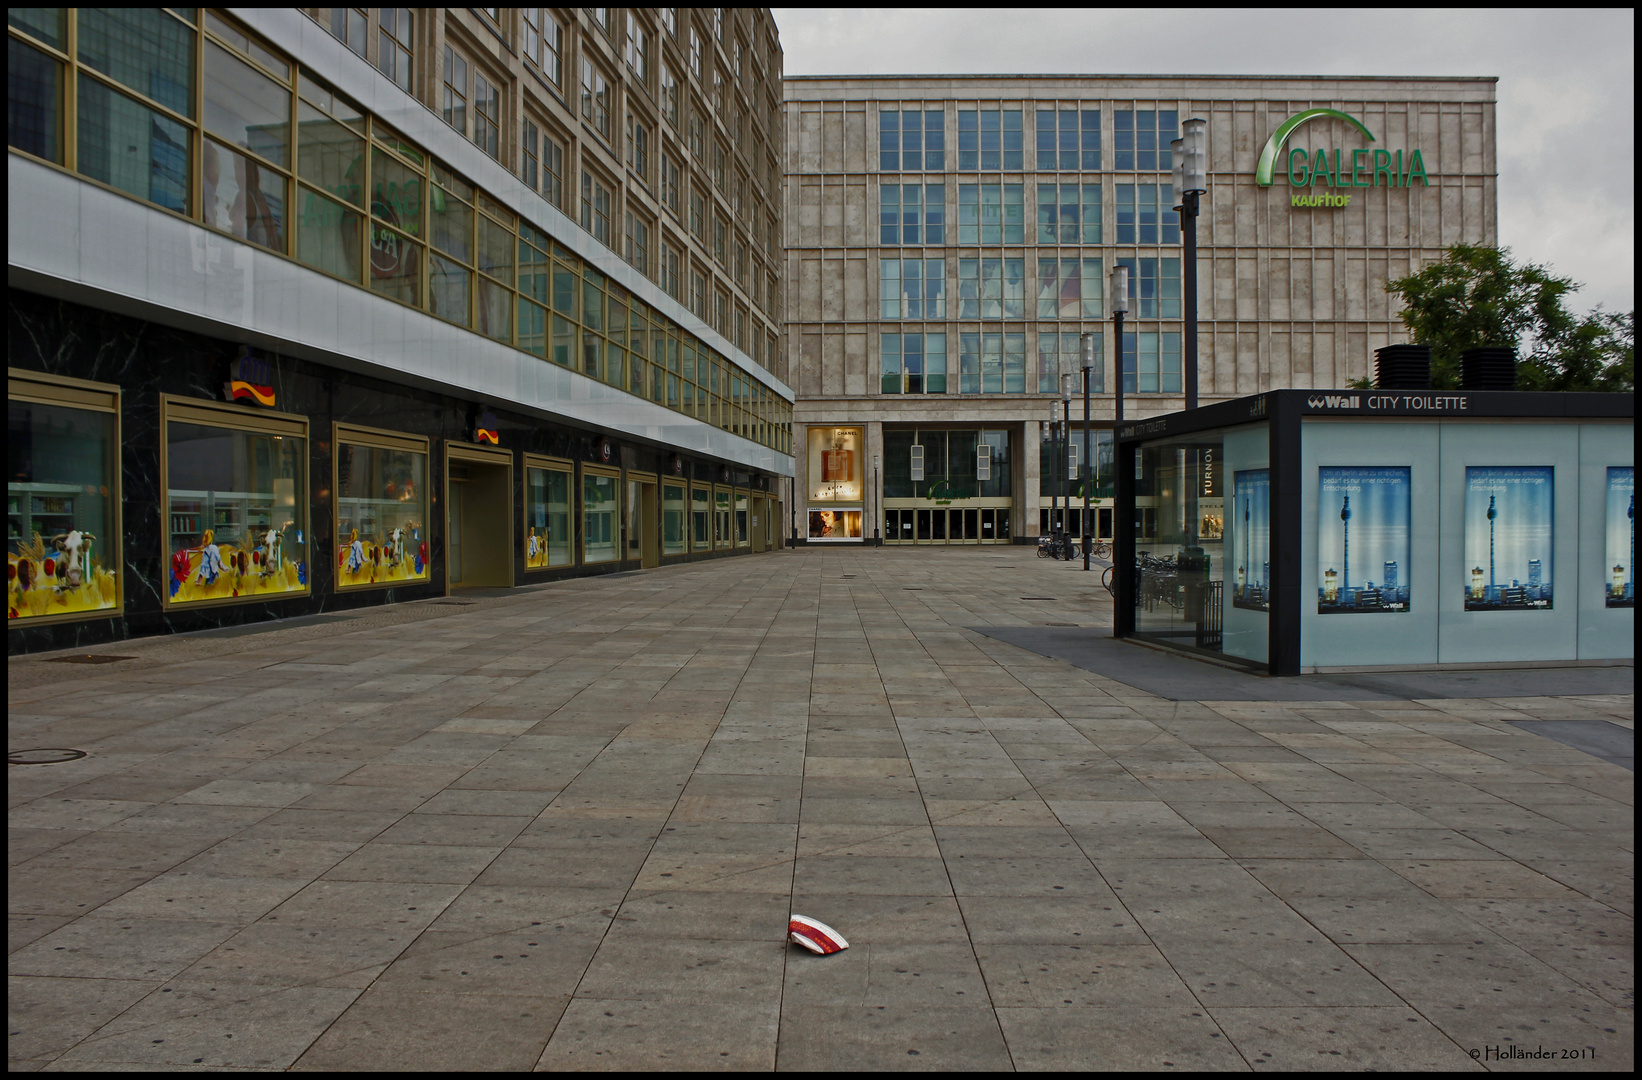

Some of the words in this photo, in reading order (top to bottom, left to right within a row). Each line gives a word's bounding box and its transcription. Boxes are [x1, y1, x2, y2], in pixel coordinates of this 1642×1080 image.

[1287, 148, 1429, 188] GALERIA
[239, 345, 271, 385] dm
[1325, 395, 1360, 409] Wall
[1368, 396, 1399, 409] CITY
[1403, 396, 1467, 409] TOILETTE
[1136, 423, 1145, 435] CITY
[1146, 419, 1167, 433] TOILETTE
